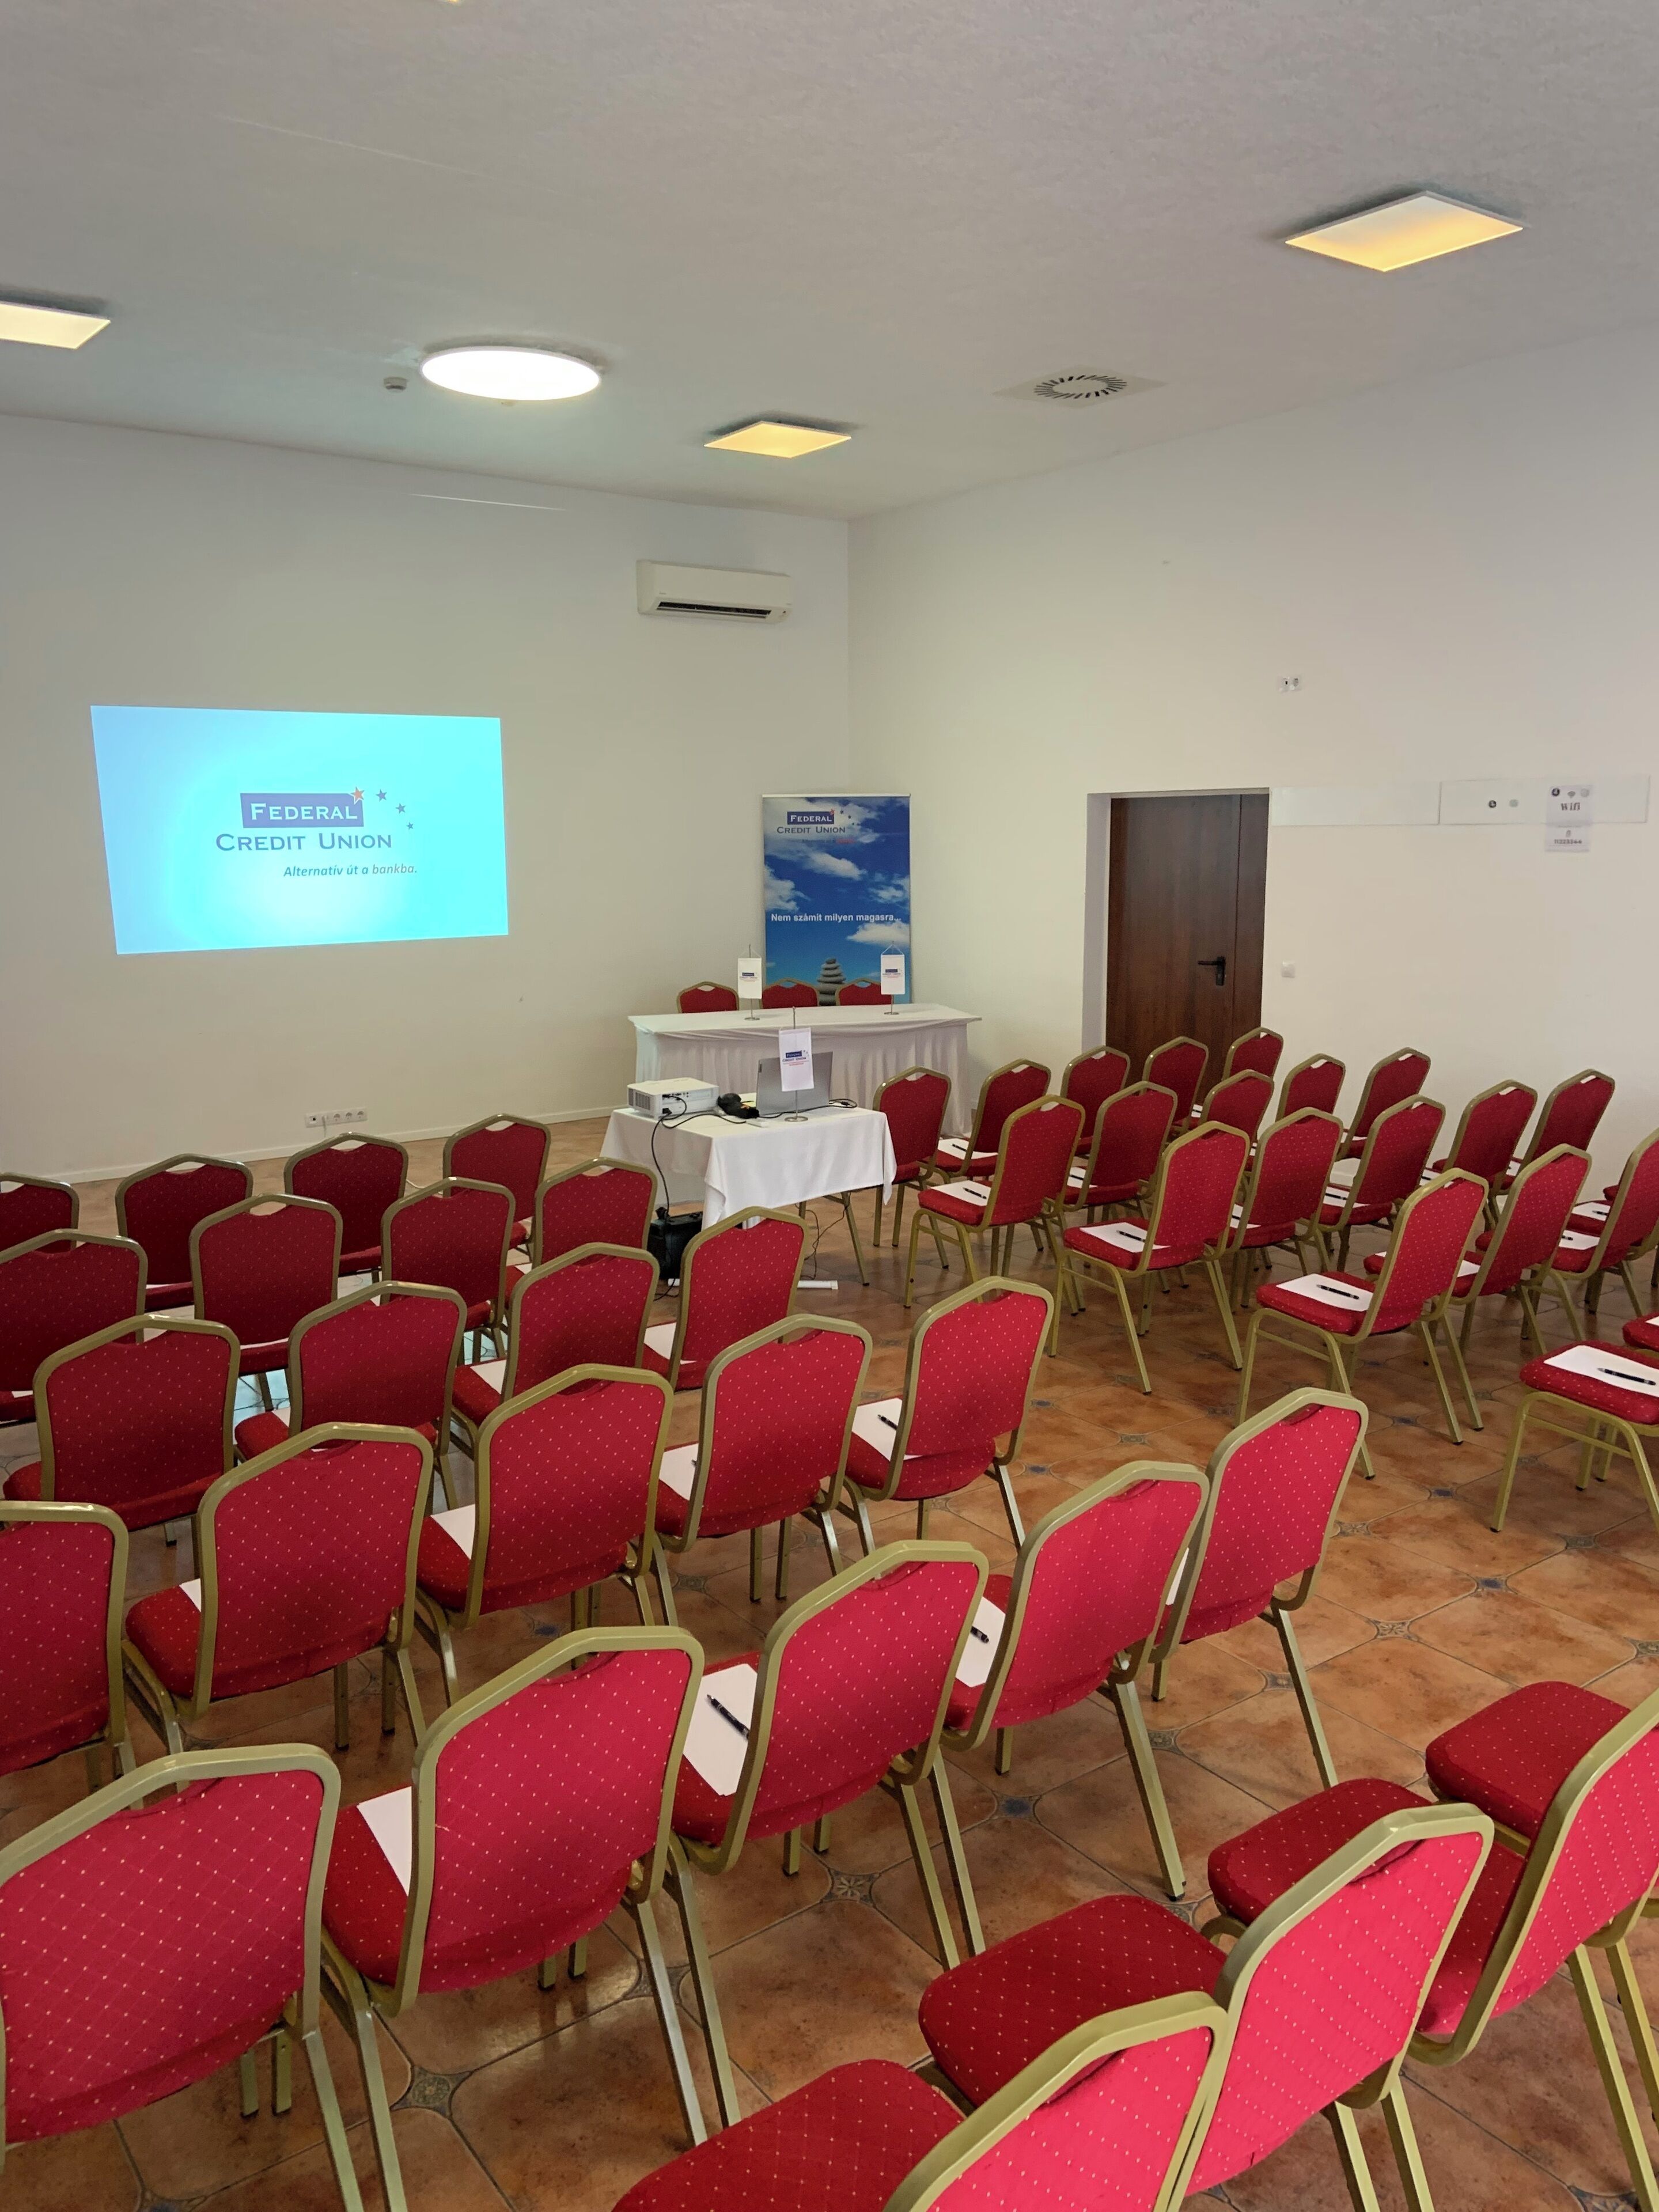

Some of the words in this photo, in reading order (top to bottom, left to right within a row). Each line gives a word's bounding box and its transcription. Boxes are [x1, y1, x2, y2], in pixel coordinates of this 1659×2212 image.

[250, 802, 358, 820] FEDERAL
[790, 815, 832, 823] FEDERAL
[777, 826, 811, 834] CREDIT
[215, 833, 306, 851] CREDIT
[319, 832, 392, 850] UNION
[283, 864, 343, 877] Alternatív
[347, 864, 358, 875] út
[362, 867, 369, 875] a
[372, 863, 417, 875] bankba.
[771, 913, 791, 922] Nem
[794, 912, 822, 922] számít
[824, 912, 853, 923] milyen
[856, 914, 902, 923] magasra...
